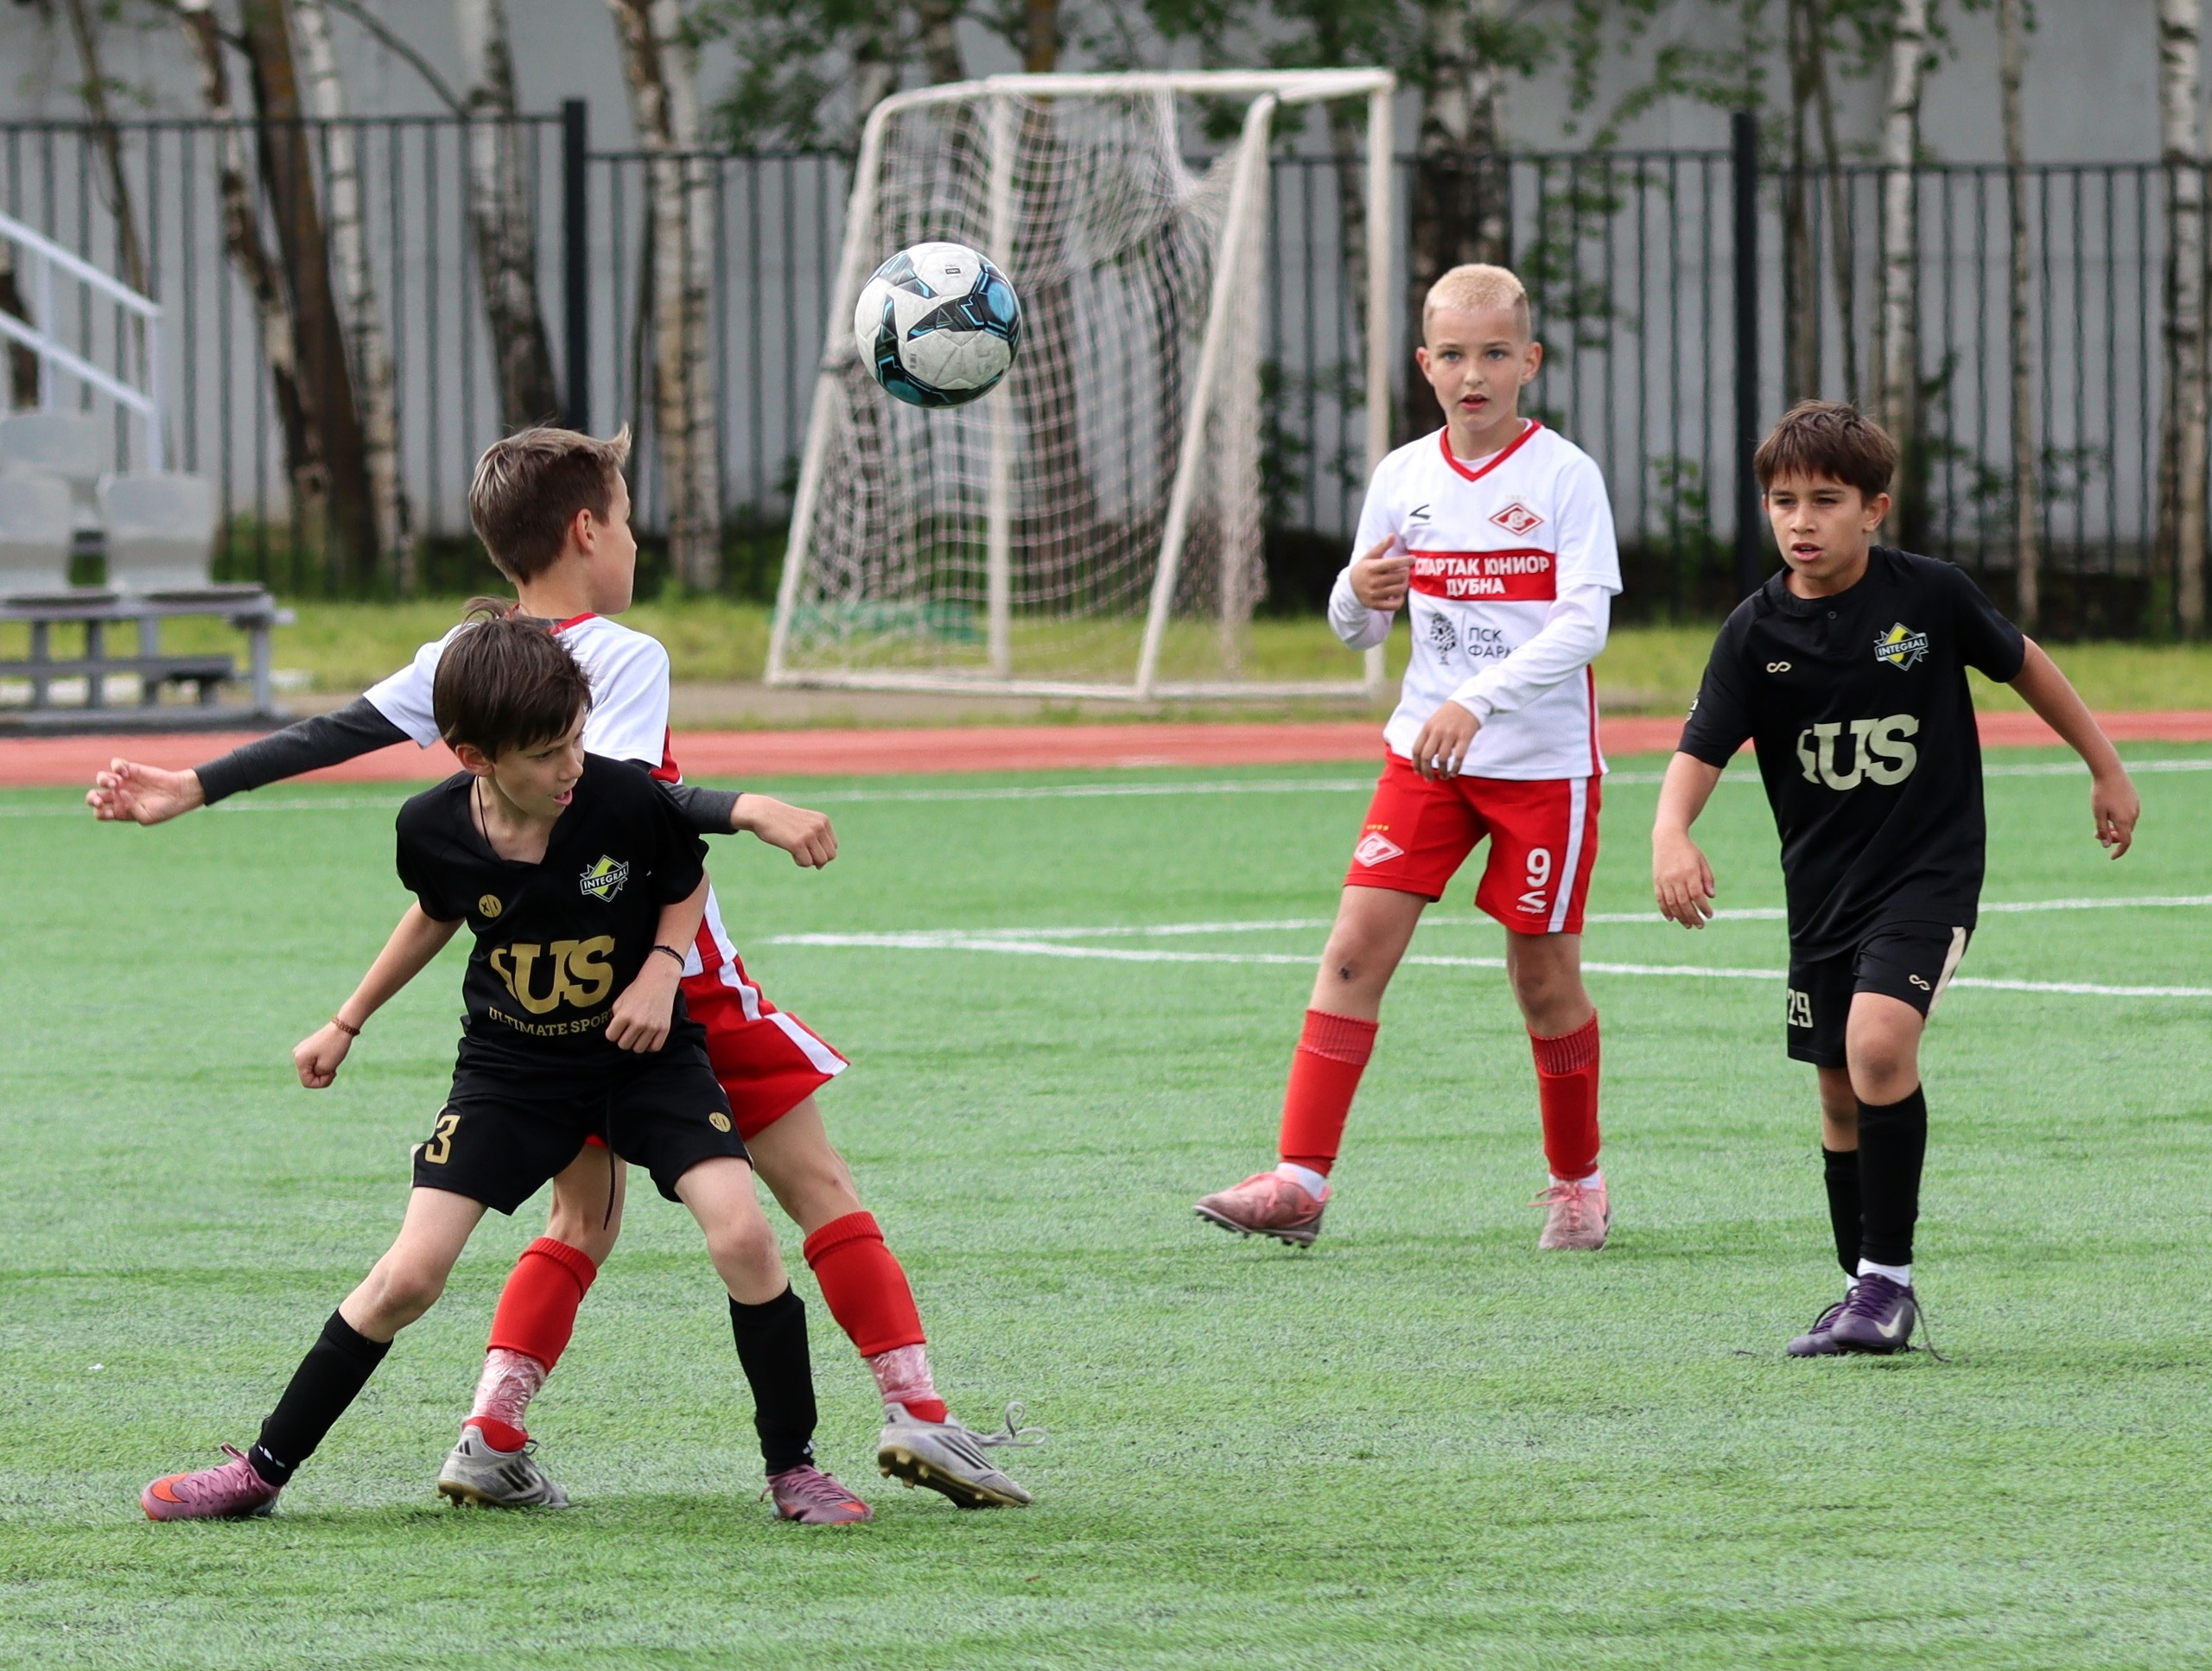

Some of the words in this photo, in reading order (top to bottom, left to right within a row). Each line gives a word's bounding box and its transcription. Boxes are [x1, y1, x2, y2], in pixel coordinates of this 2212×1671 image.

[1484, 556, 1550, 575] ЮНИОР
[1446, 577, 1506, 596] ДУБНА
[1469, 626, 1503, 643] ПСК
[1878, 638, 1926, 657] INTEGRAL
[583, 867, 627, 890] INTEGRAL
[1526, 848, 1551, 887] 9
[1788, 988, 1814, 1028] 29
[488, 1006, 568, 1037] ULTIMATE
[424, 1115, 461, 1165] 3
